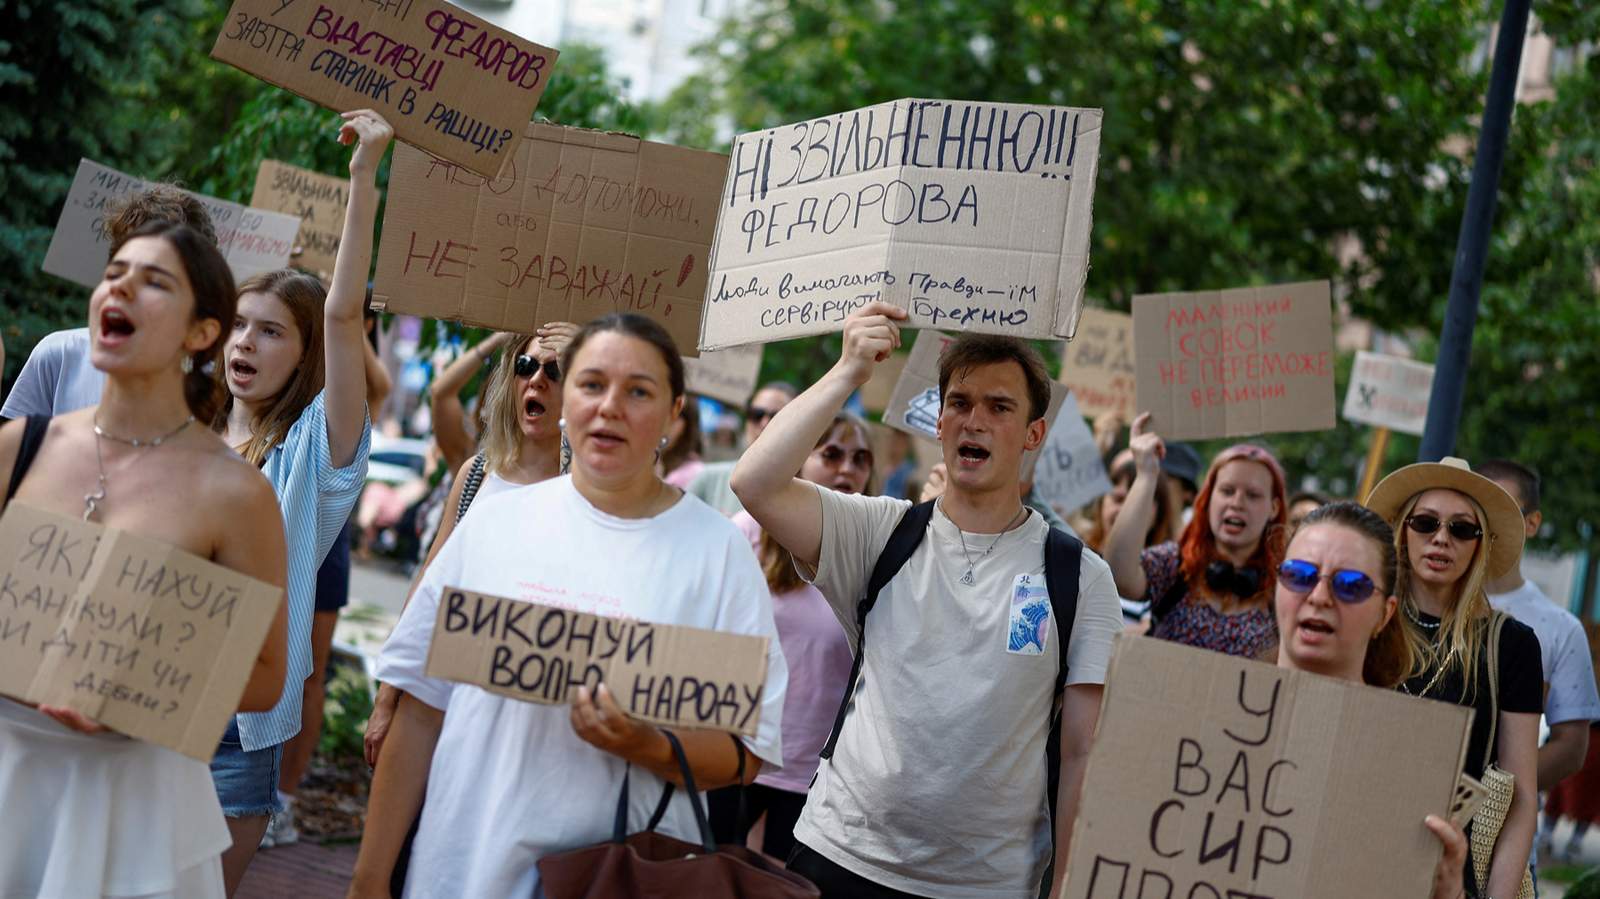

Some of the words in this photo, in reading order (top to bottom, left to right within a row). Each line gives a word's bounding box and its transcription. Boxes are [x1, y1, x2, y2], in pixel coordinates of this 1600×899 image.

[225, 12, 306, 63] ЗАВТРА
[310, 49, 397, 104] СТАРЛІНК
[399, 86, 416, 116] В
[424, 102, 513, 154] РАШЦІ?
[306, 5, 445, 92] ВІДСТАВЦІ
[425, 9, 547, 90] ФЕДОРОВ
[729, 130, 775, 208] НІ
[777, 100, 1079, 188] ЗВІЛЬНЕННЮ!!!
[533, 164, 700, 225] ДОПОМОЖИ.
[742, 179, 980, 254] ФЕДОРОВА
[403, 231, 478, 278] НЕ
[496, 246, 696, 317] ЗАВАЖАЙ!
[712, 273, 770, 303] Люди
[912, 297, 1028, 327] Брехню
[1158, 358, 1191, 385] НЕ
[1199, 351, 1330, 385] ПЕРЕМОЖЕ
[1178, 320, 1277, 358] СОВОК
[20, 524, 101, 582] ЯКІ
[116, 556, 242, 628] НАХУЙ
[0, 617, 32, 647] И
[40, 628, 140, 671] ДІТИ
[153, 660, 193, 694] ЧИ
[444, 591, 656, 666] ВИКОНУЙ
[490, 645, 603, 703] ВОЛЮ
[630, 673, 764, 729] НАРОДУ
[1222, 670, 1283, 746] У
[1173, 738, 1298, 818] ВАС
[1150, 799, 1293, 881] СИР
